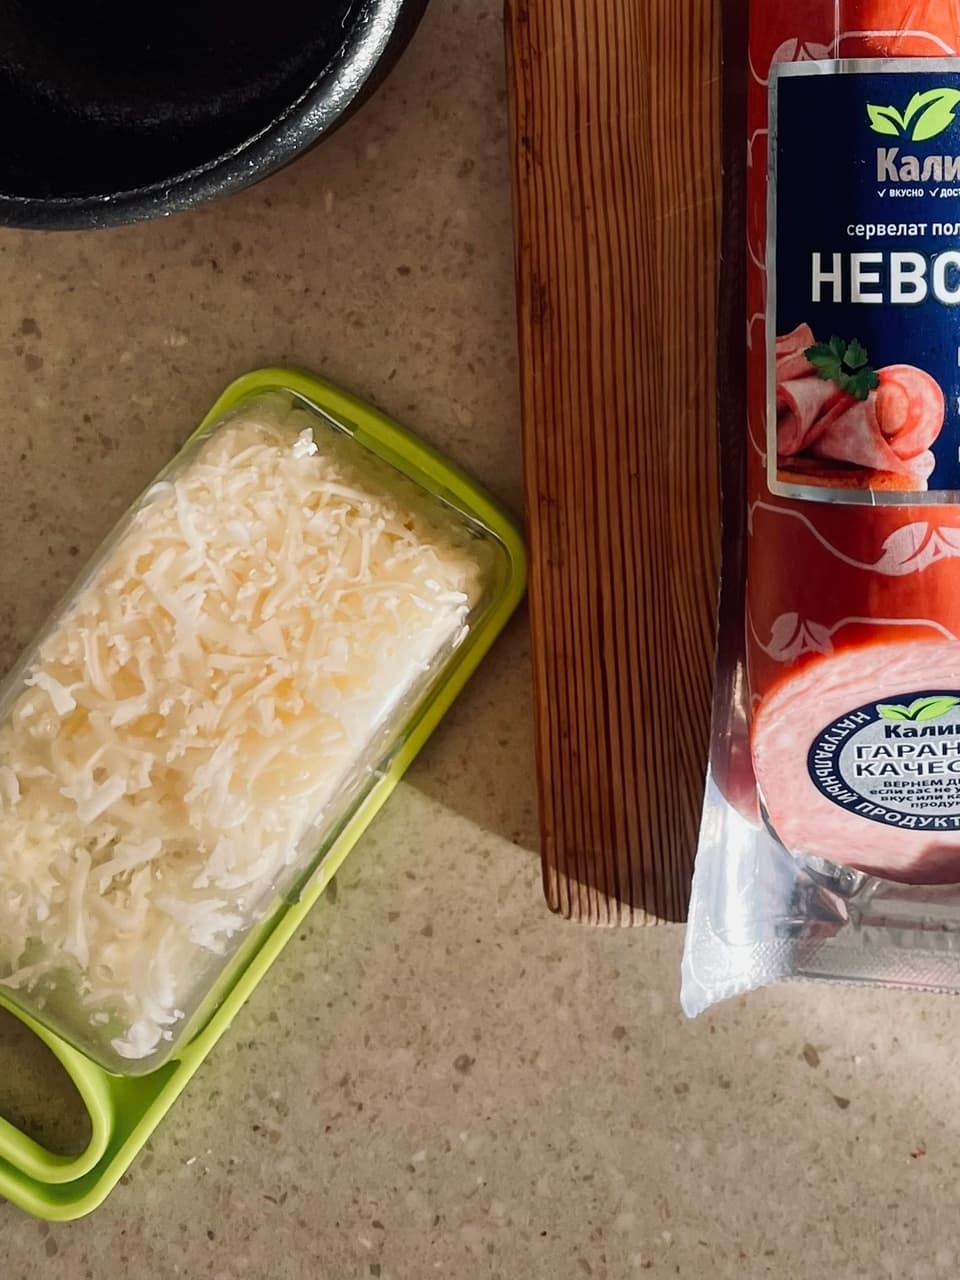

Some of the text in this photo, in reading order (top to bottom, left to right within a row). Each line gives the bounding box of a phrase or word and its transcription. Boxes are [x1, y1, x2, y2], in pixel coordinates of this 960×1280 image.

[889, 188, 925, 197] ВКУСНО
[846, 222, 928, 240] сервелат
[814, 711, 871, 804] НАТУРАЛЬНЫЙ
[883, 778, 943, 788] ВЕРНЕМ
[869, 787, 903, 795] если
[906, 786, 931, 795] вас
[880, 795, 913, 804] вкус
[916, 793, 944, 801] или
